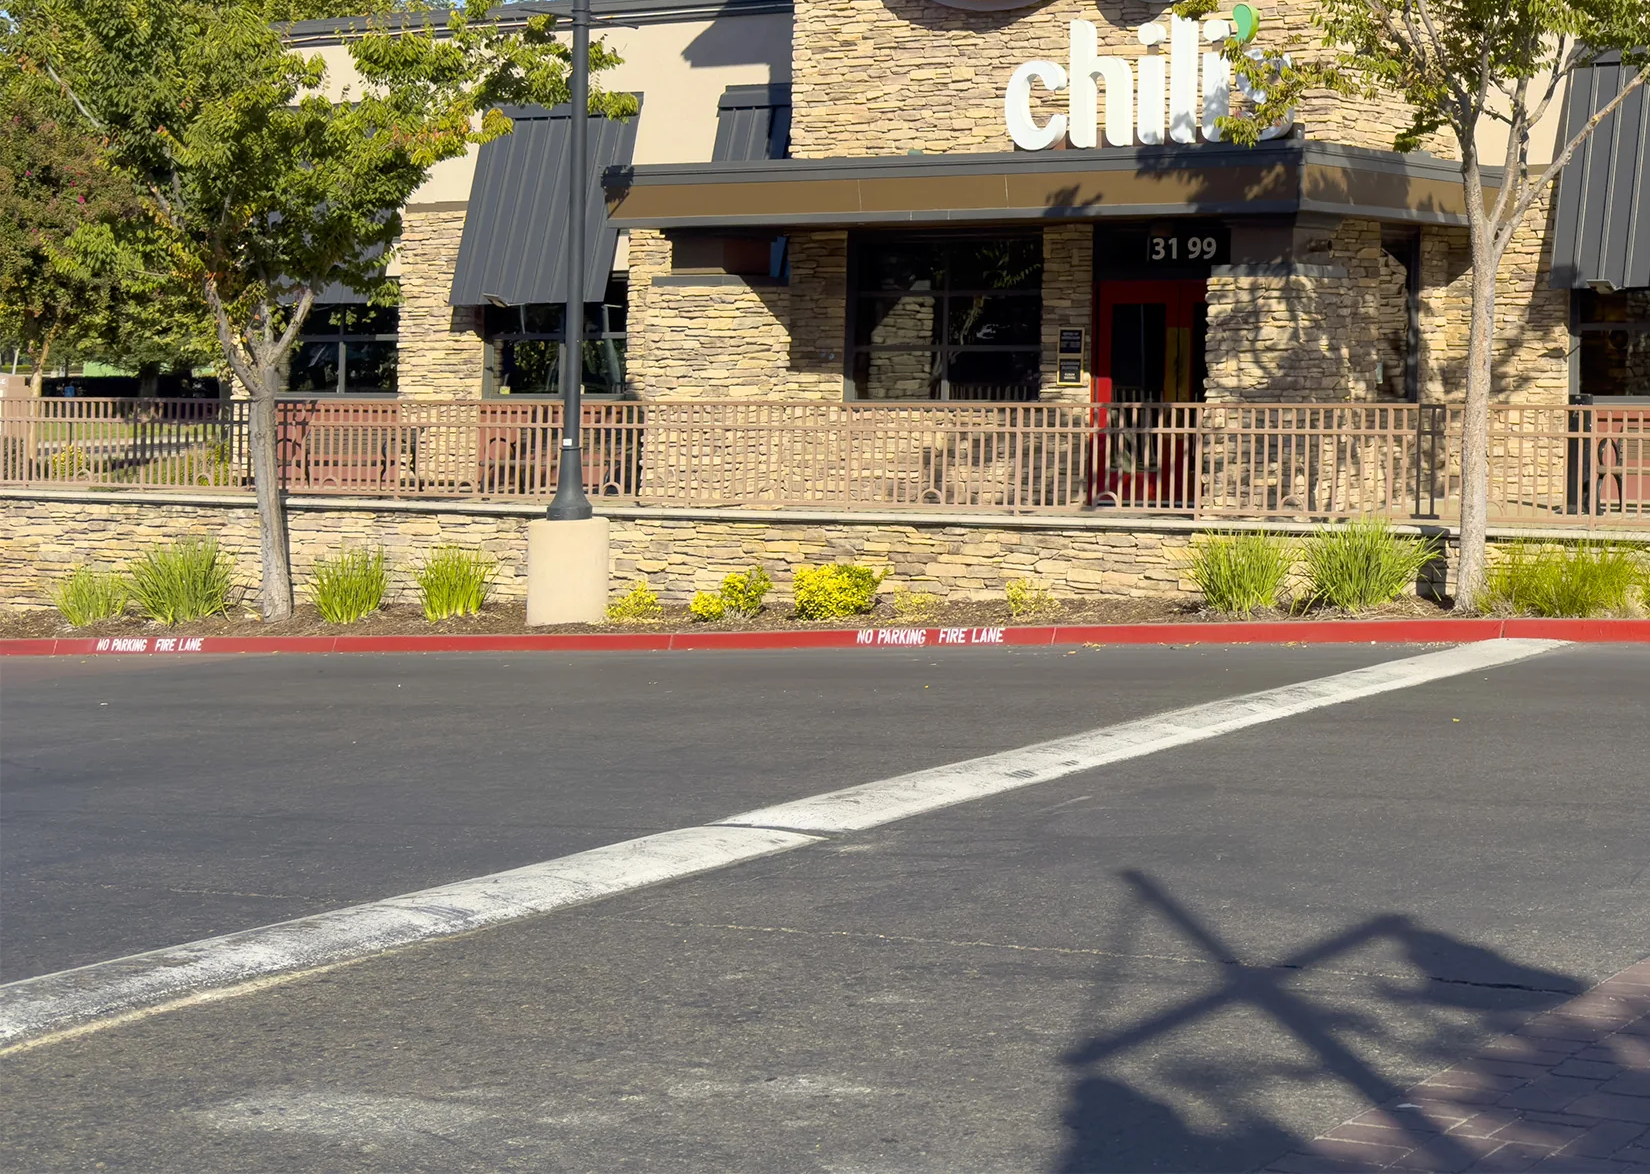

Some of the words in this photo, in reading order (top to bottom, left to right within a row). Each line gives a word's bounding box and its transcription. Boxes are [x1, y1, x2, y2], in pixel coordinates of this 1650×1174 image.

[96, 639, 109, 651] NO
[111, 638, 147, 652] PARKING
[154, 638, 177, 652] FIRE
[178, 637, 204, 651] LANE
[856, 629, 873, 644] NO
[877, 628, 926, 645] PARKING
[938, 628, 970, 644] FIRE
[971, 628, 1006, 644] LANE
